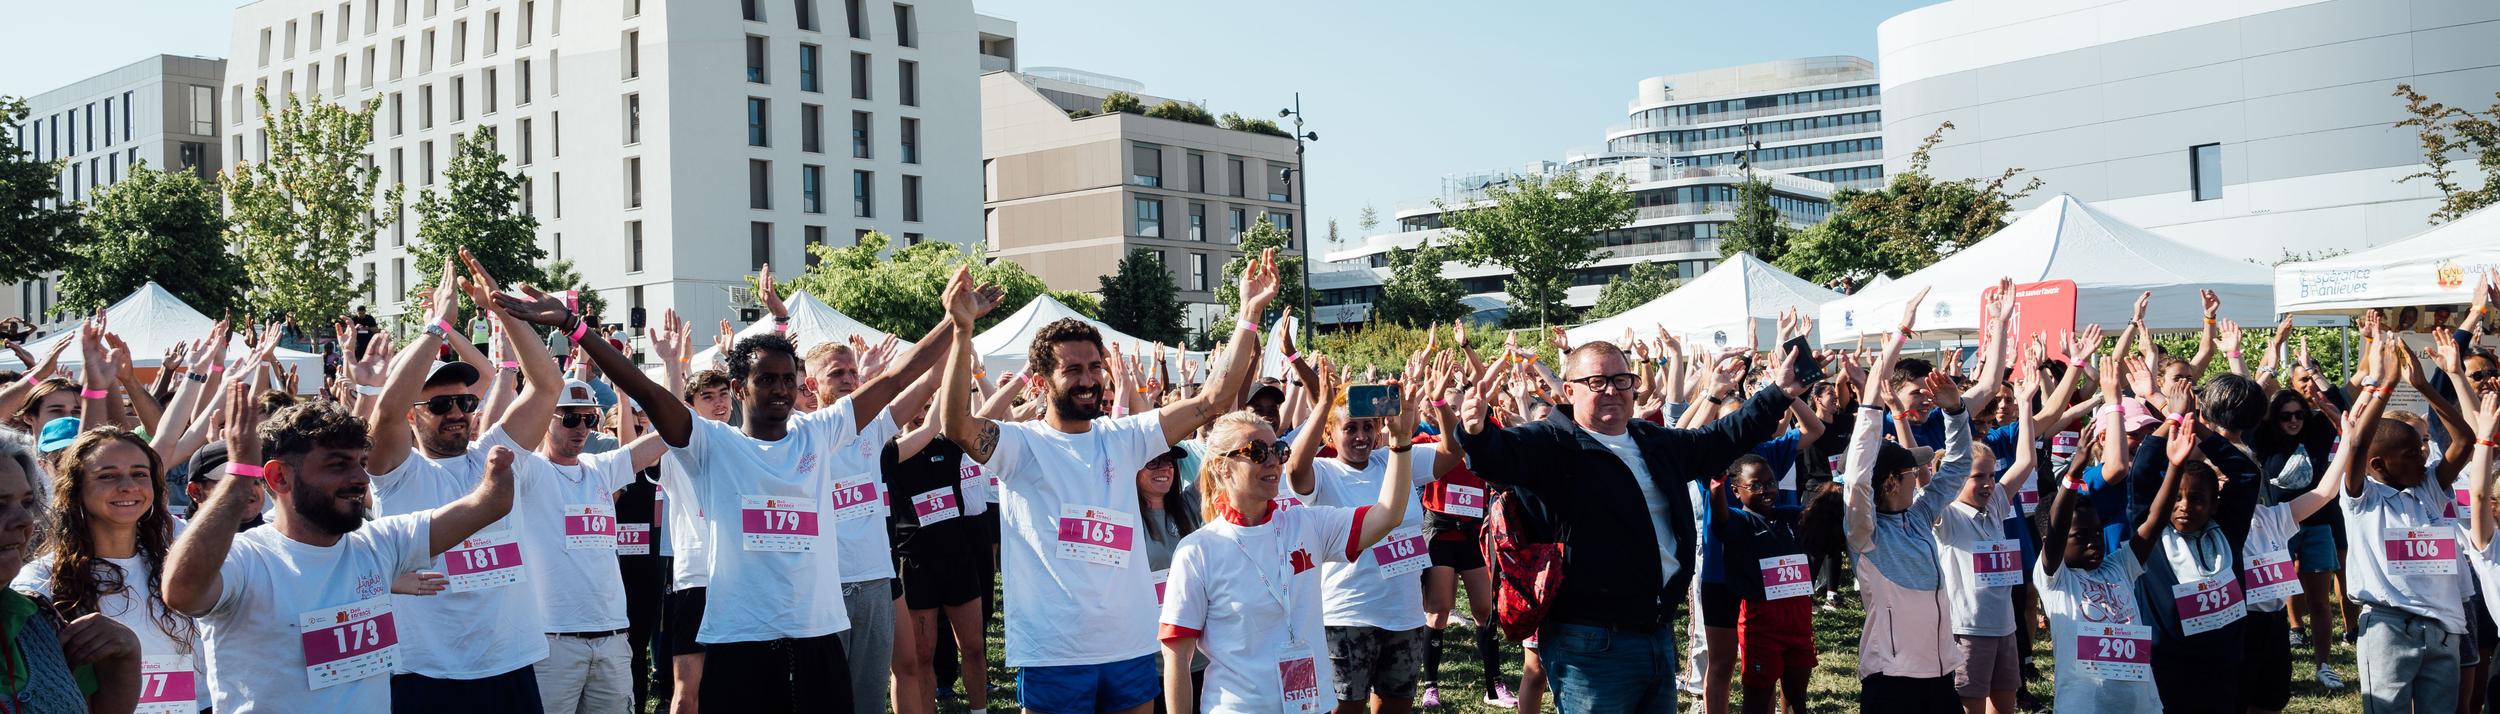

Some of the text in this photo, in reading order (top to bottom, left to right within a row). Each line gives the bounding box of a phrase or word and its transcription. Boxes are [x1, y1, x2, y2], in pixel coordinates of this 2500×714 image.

[2059, 437, 2070, 445] 64
[834, 487, 863, 506] 176
[930, 498, 945, 511] 58
[1459, 494, 1471, 505] 68
[582, 516, 606, 532] 169
[764, 511, 800, 531] 179
[618, 532, 640, 543] 412
[1081, 521, 1115, 543] 165
[1388, 540, 1415, 559] 168
[2405, 540, 2439, 557] 106
[463, 547, 499, 570] 181
[1989, 553, 2011, 569] 115
[1777, 566, 1802, 582] 296
[2252, 564, 2283, 584] 114
[2196, 586, 2230, 612] 295
[333, 619, 380, 654] 173
[2098, 638, 2136, 659] 290
[1285, 687, 1318, 701] STAFF
